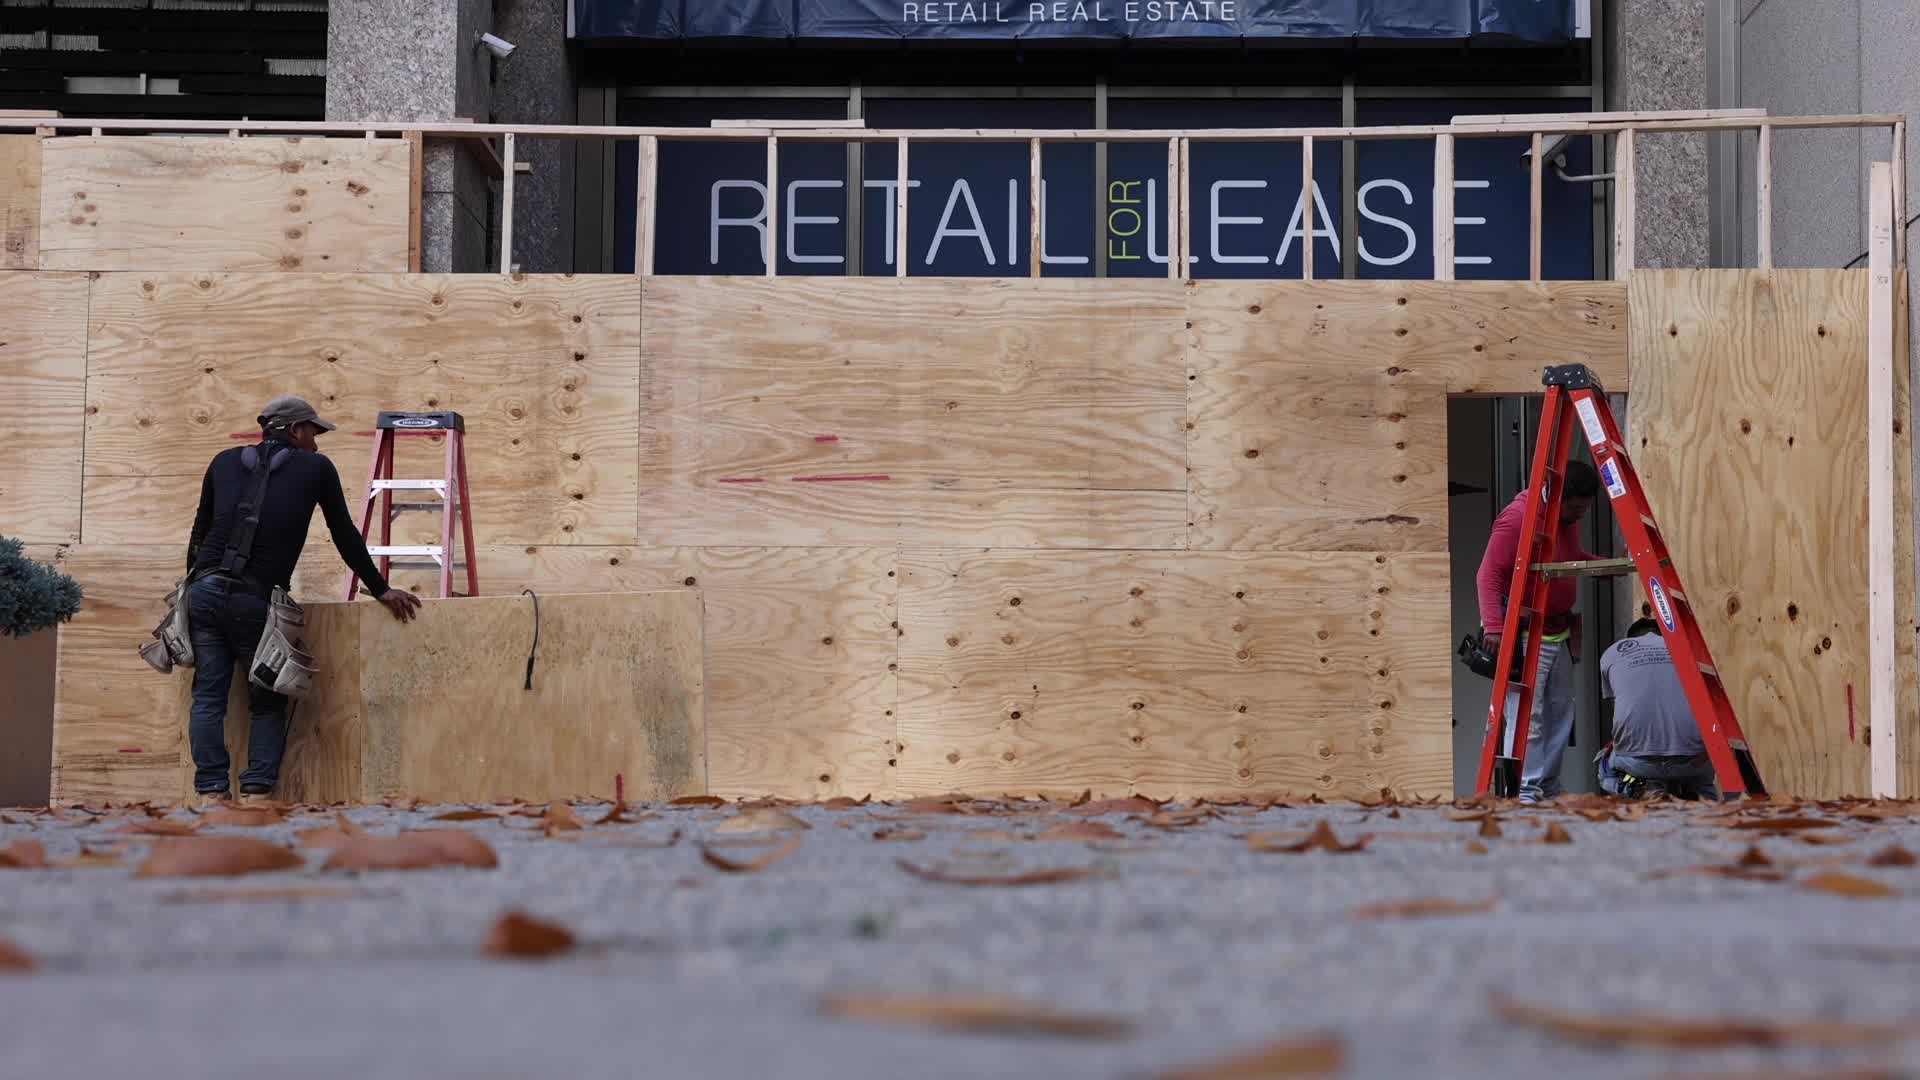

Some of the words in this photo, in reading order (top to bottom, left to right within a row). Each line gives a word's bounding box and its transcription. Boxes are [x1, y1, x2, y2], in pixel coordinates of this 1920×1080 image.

[903, 2, 1008, 22] RETAIL
[1029, 2, 1108, 21] REAL
[1125, 1, 1235, 21] ESTATE
[710, 178, 1089, 265] RETAIL
[1109, 180, 1142, 259] FOR
[1147, 178, 1492, 265] LEASE
[1654, 588, 1671, 621] WERNER
